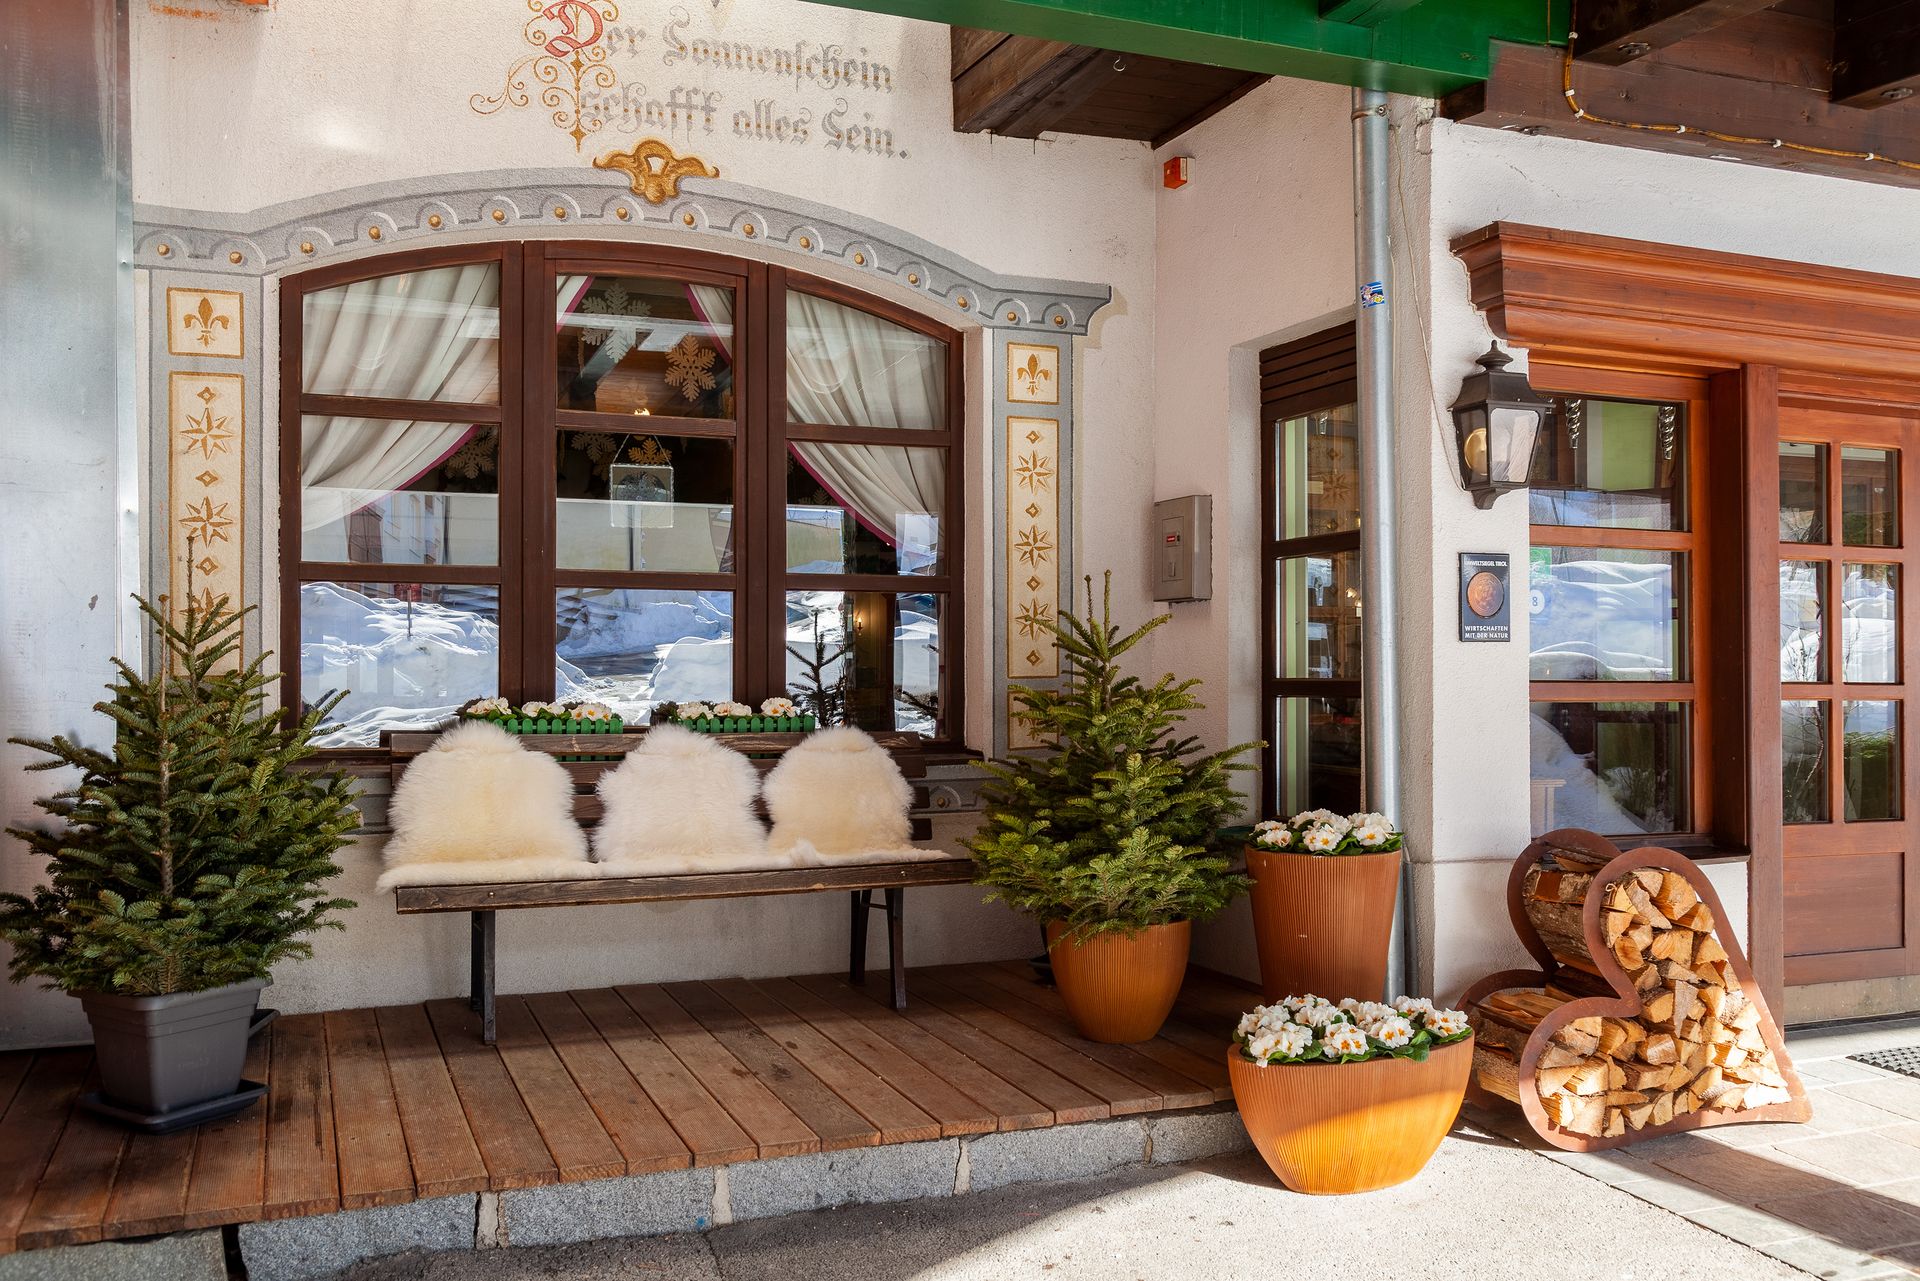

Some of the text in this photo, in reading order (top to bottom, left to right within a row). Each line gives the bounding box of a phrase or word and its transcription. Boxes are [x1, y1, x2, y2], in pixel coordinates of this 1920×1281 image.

[542, 0, 894, 94] Der Sonnenschein
[580, 80, 911, 159] schafft alles Sein.
